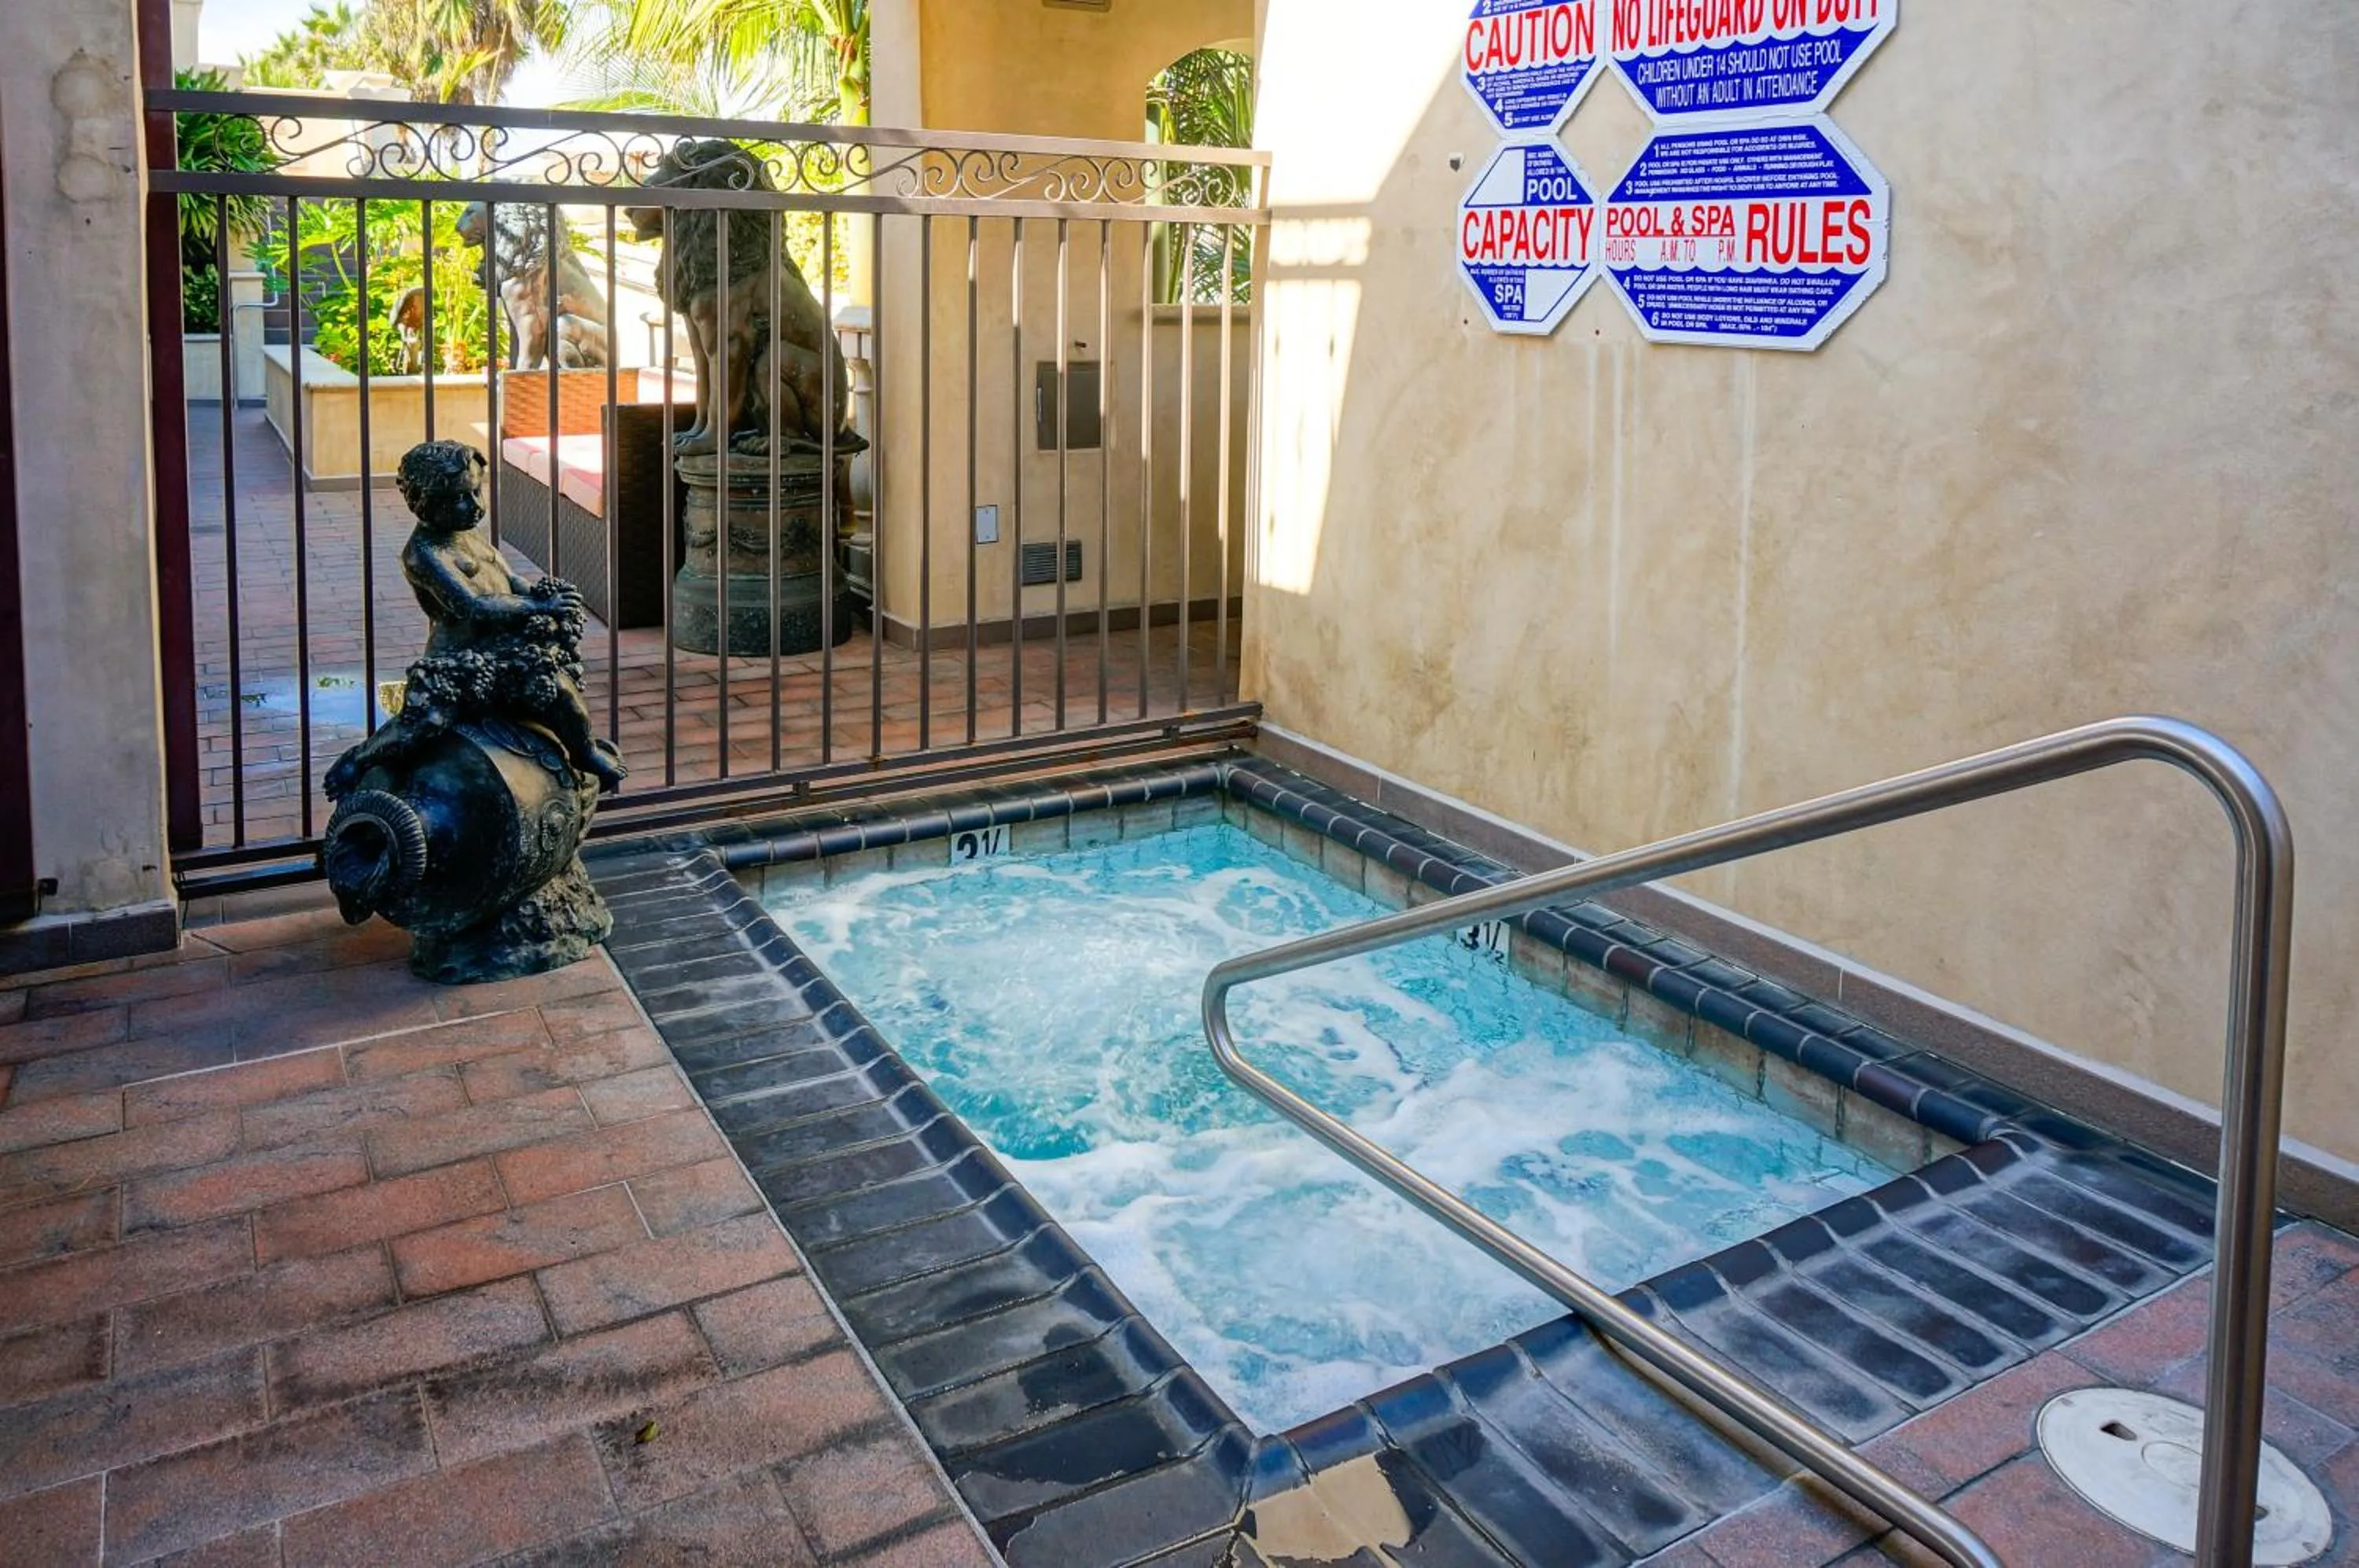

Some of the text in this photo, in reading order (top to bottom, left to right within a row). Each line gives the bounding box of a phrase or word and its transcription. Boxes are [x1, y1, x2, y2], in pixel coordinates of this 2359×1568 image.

[1612, 0, 1641, 52] NO
[1466, 0, 1595, 72] CAUTION
[1637, 39, 1842, 85] CHILDREN UNDER 14 SHOULD NOT USE POOL
[1477, 76, 1485, 91] 3
[1655, 70, 1818, 108] WITHOUT AN ADULT IN ATTENDANCE
[1494, 98, 1503, 112] 4
[1504, 112, 1513, 126] 5
[1654, 145, 1659, 157] 1
[1640, 162, 1647, 176] 2
[1526, 177, 1577, 201] POOL
[1625, 180, 1632, 195] 3
[1462, 208, 1594, 260] CAPACITY
[1606, 199, 1871, 265] POOL & SPA RULES
[1605, 240, 1636, 261] HOURS
[1661, 239, 1680, 262] A.M.
[1684, 239, 1696, 261] TO
[1623, 276, 1630, 290] 4
[1495, 284, 1523, 304] SPA
[1638, 293, 1645, 308] 5
[1652, 311, 1659, 326] 6
